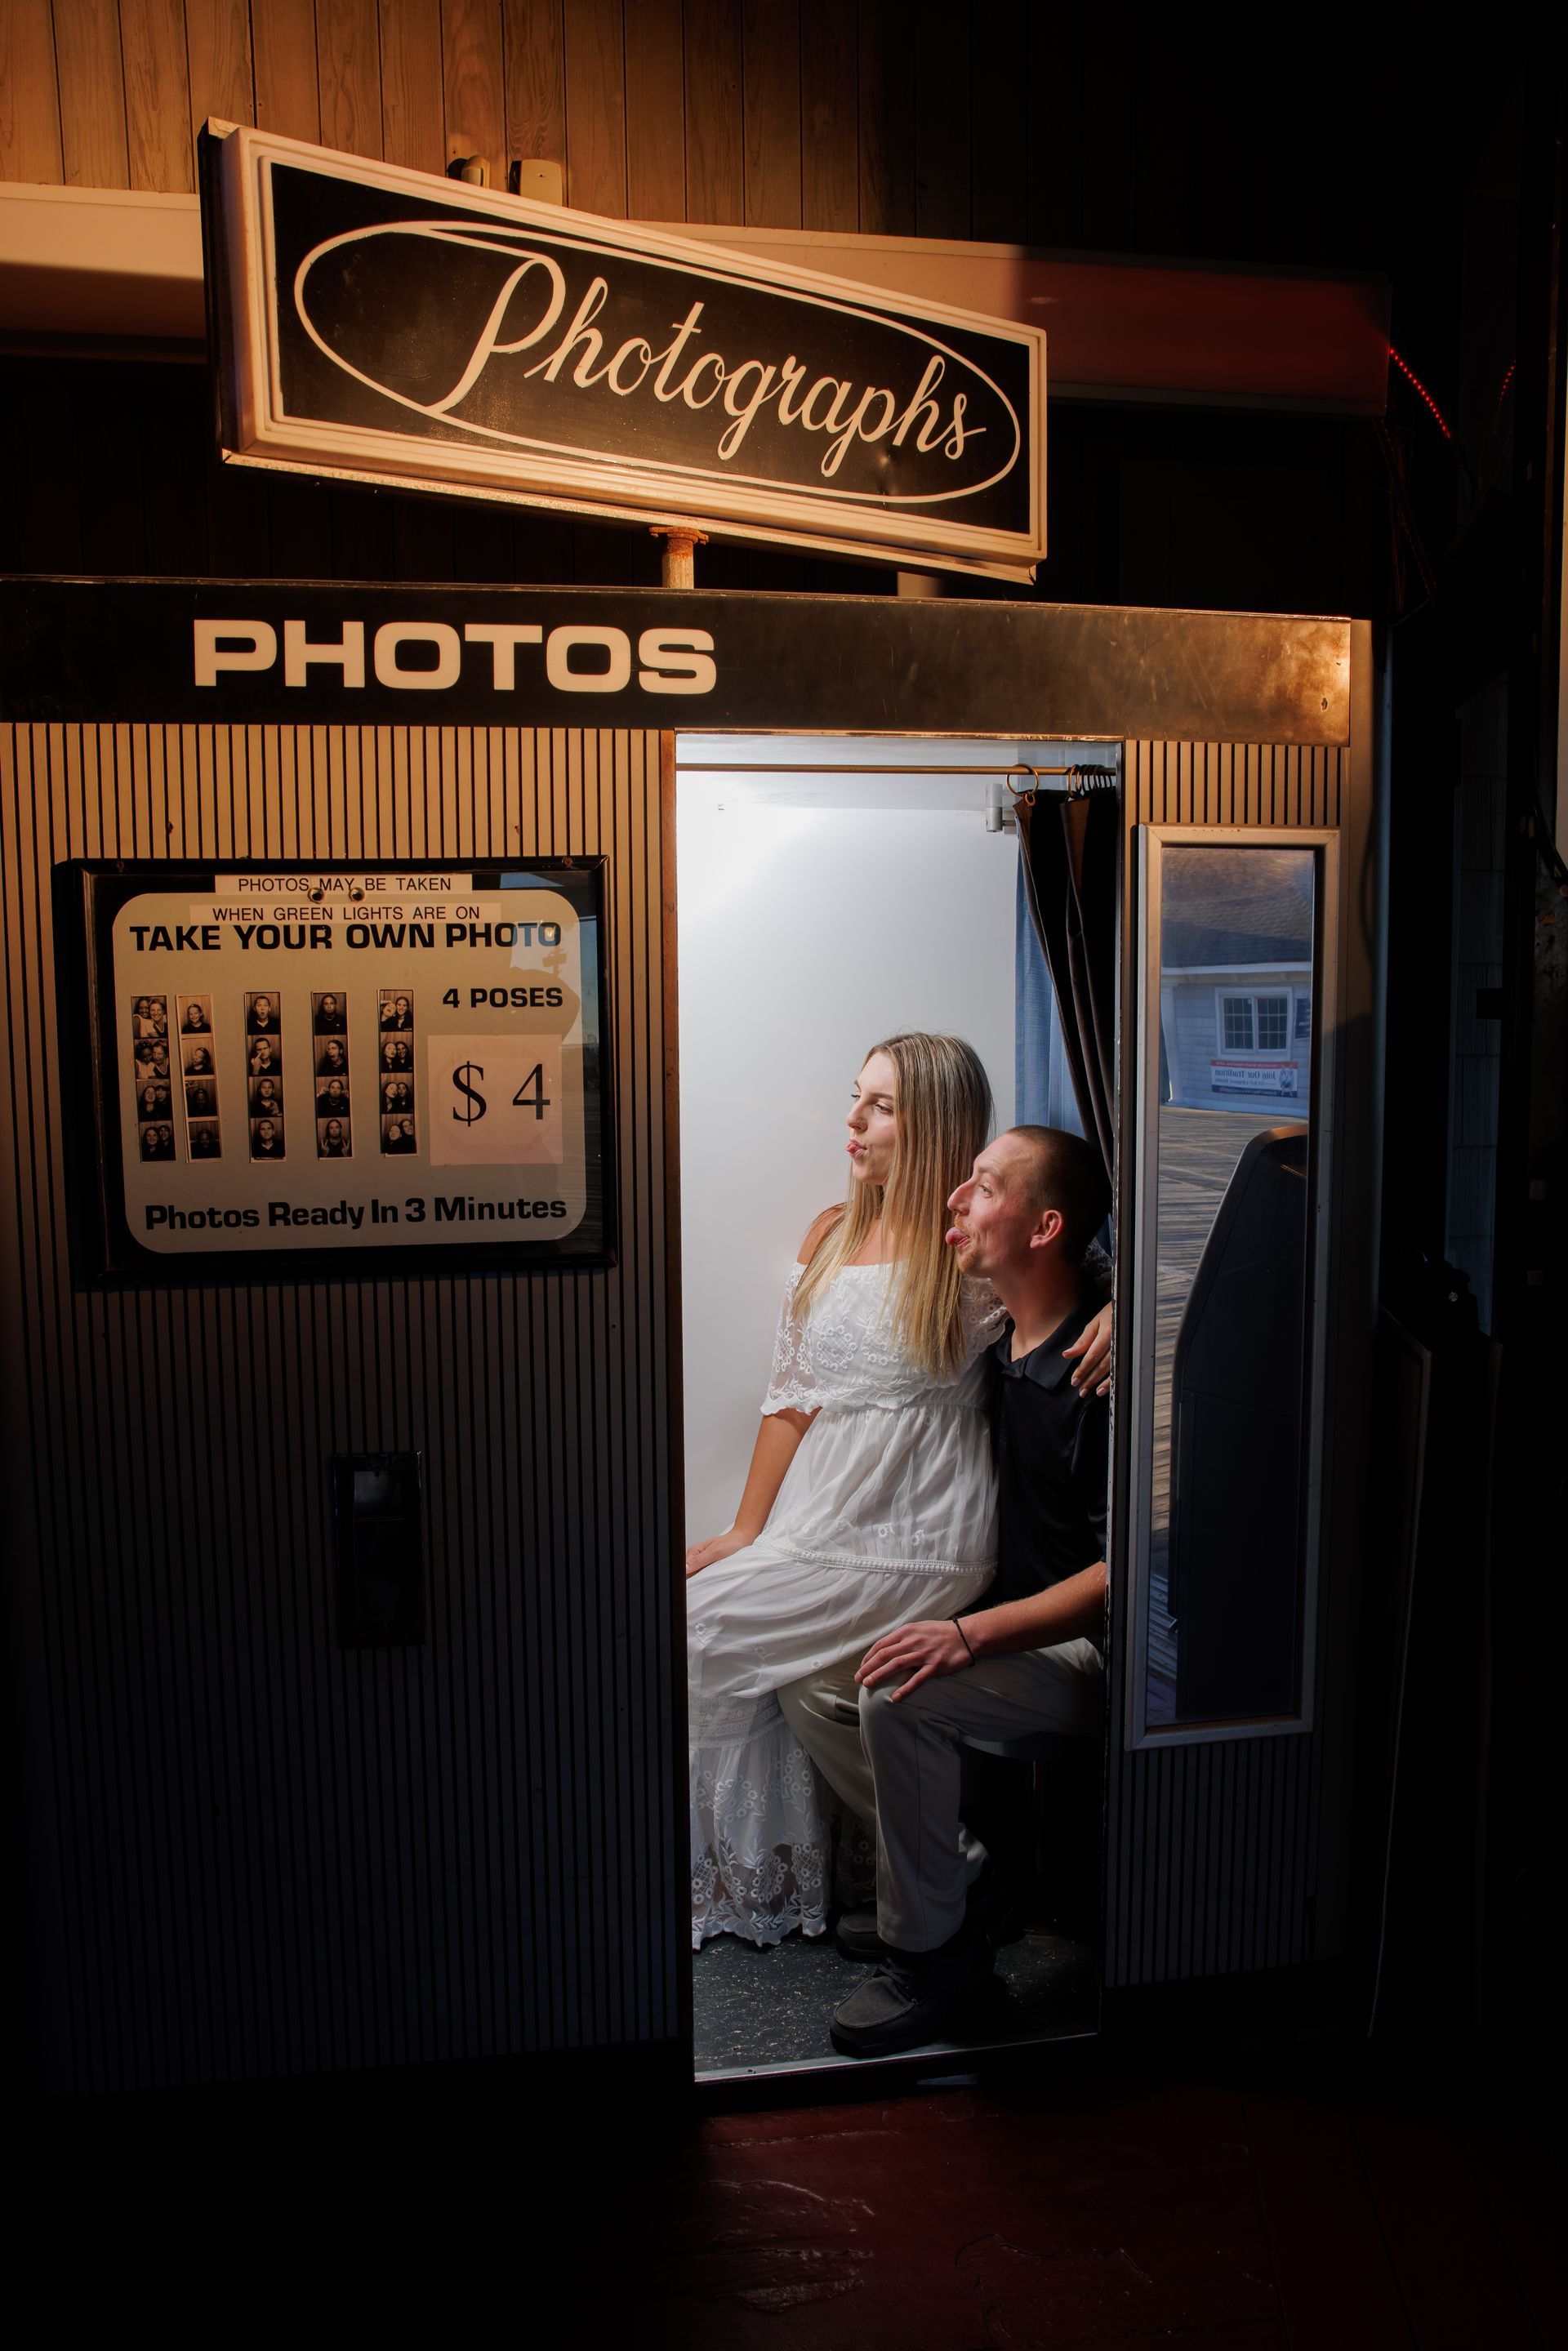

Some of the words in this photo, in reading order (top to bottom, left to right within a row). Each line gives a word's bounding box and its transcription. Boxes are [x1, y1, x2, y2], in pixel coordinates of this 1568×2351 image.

[425, 249, 987, 478] Photographs
[194, 619, 717, 695] PHOTOS
[238, 878, 310, 892] PHOTOS
[318, 877, 355, 892] MAY
[365, 877, 386, 891] BE
[395, 877, 452, 891] TAKEN
[212, 907, 264, 921] WHEN
[274, 906, 333, 920] GREEN
[343, 906, 403, 920] LIGHTS
[412, 906, 447, 919] ARE
[455, 906, 480, 919] ON
[129, 925, 221, 951] TAKE
[233, 924, 332, 950] YOUR
[346, 923, 435, 949] OWN
[446, 922, 562, 948] PHOTO
[443, 988, 461, 1009] 4
[470, 986, 564, 1009] POSES
[452, 1060, 488, 1128] $
[512, 1063, 551, 1120] 4
[145, 1204, 260, 1231] Photos
[268, 1200, 365, 1230] Ready
[371, 1199, 399, 1223] In
[405, 1197, 426, 1222] 3
[434, 1196, 567, 1222] Minutes
